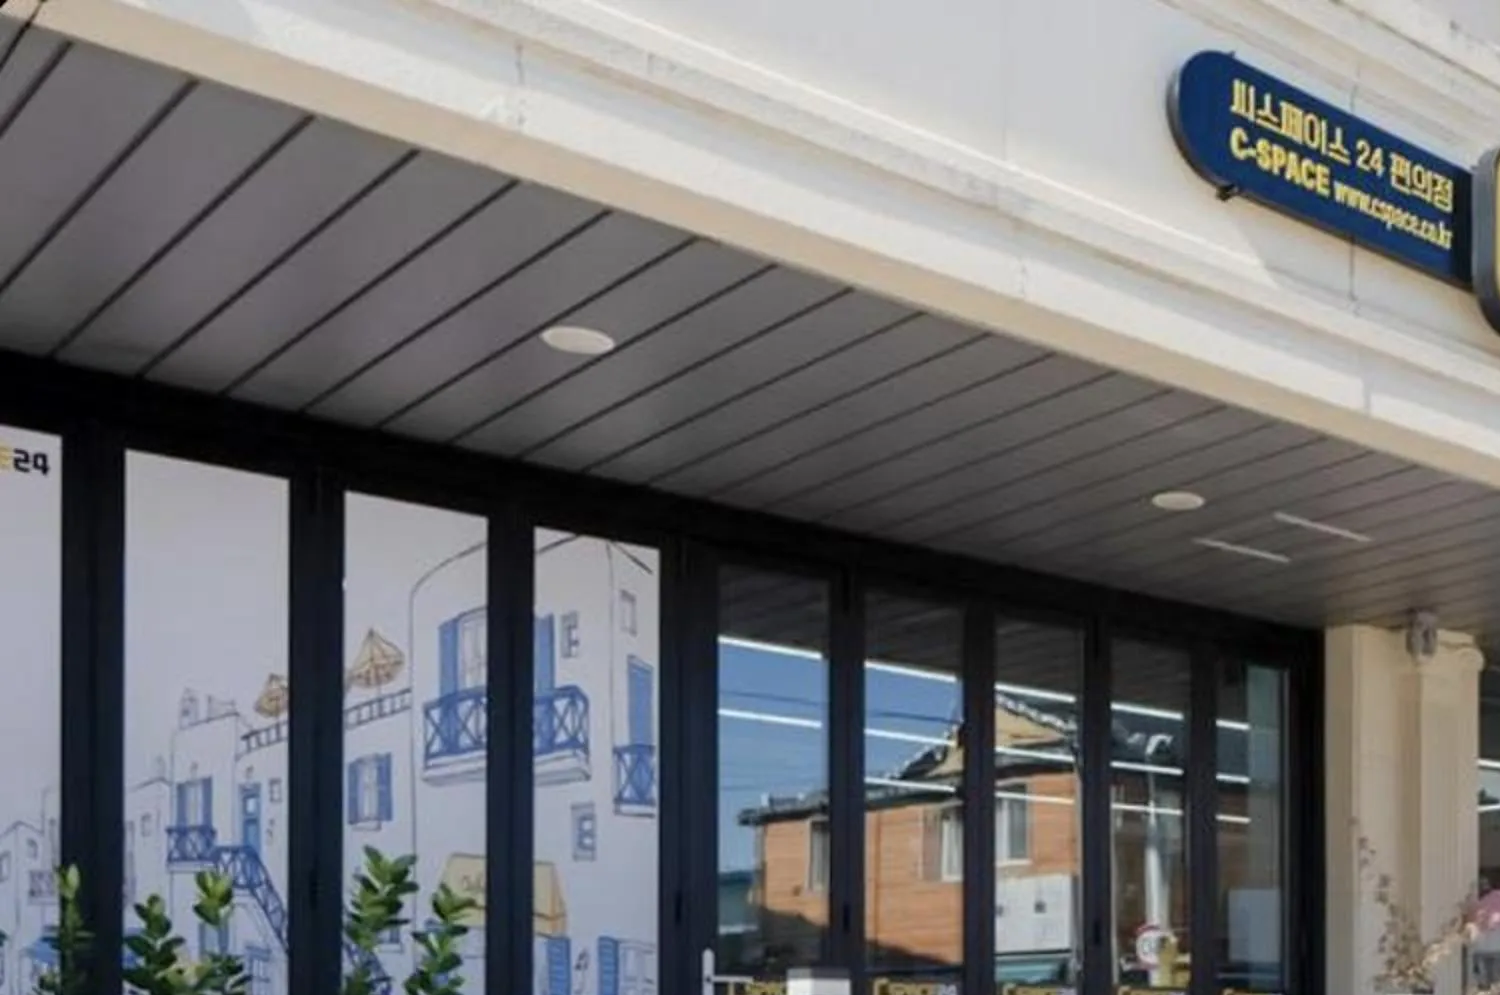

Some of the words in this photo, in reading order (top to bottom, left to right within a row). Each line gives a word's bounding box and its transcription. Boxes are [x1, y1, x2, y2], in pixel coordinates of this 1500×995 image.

[1230, 127, 1331, 196] C-SPACE
[1356, 138, 1386, 176] 24
[1390, 152, 1454, 213] 편의점
